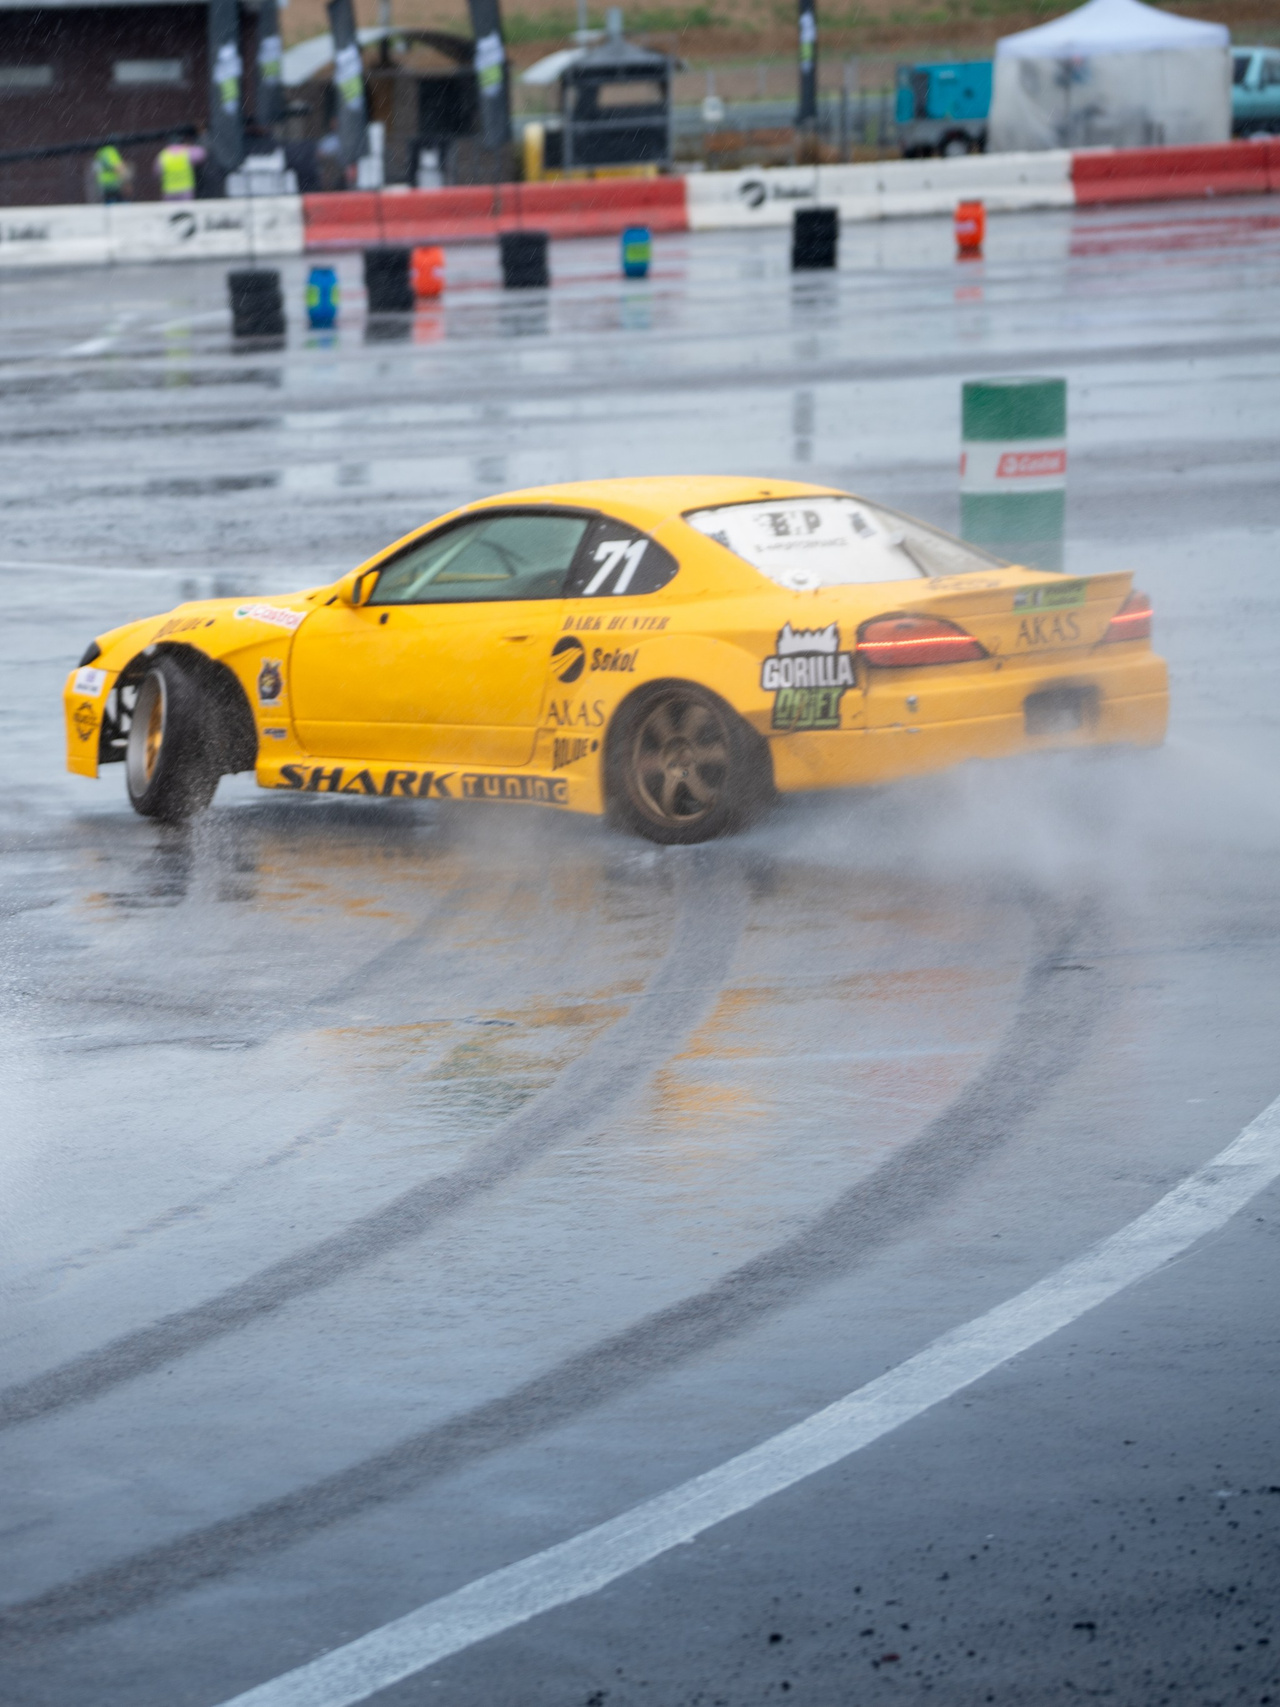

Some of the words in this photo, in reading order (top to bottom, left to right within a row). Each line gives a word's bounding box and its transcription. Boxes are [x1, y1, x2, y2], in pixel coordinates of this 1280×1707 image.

[582, 539, 650, 595] 71
[1016, 612, 1081, 647] AKAS
[762, 653, 856, 690] GORILLA
[544, 698, 606, 728] AKAS
[277, 764, 458, 797] SHARK
